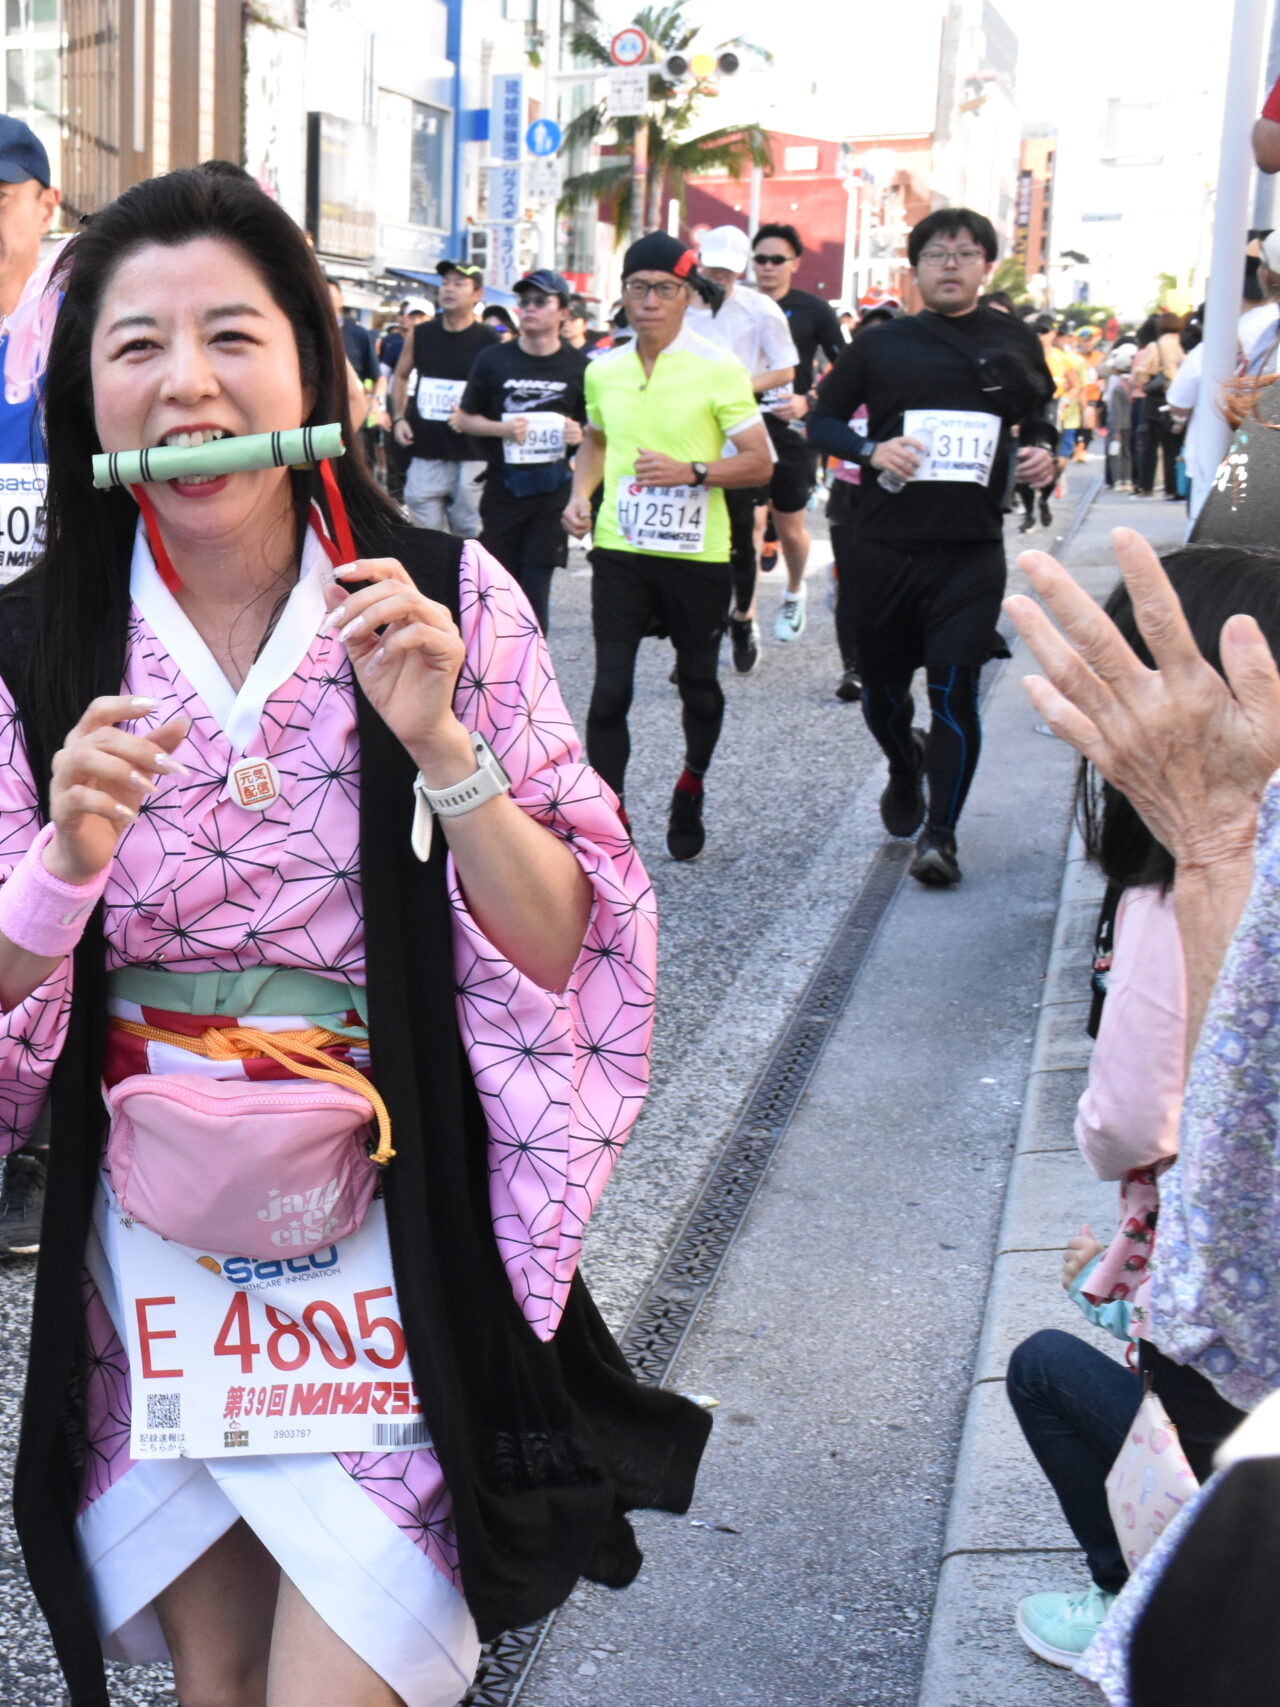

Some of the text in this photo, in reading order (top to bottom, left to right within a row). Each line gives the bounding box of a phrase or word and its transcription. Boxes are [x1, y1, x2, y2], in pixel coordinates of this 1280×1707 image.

[285, 1266, 341, 1285] INNOVATION
[135, 1286, 407, 1379] E 4805
[140, 1433, 186, 1443] 記録速報は
[273, 1429, 312, 1440] 3903787
[140, 1443, 186, 1452] こちらから
